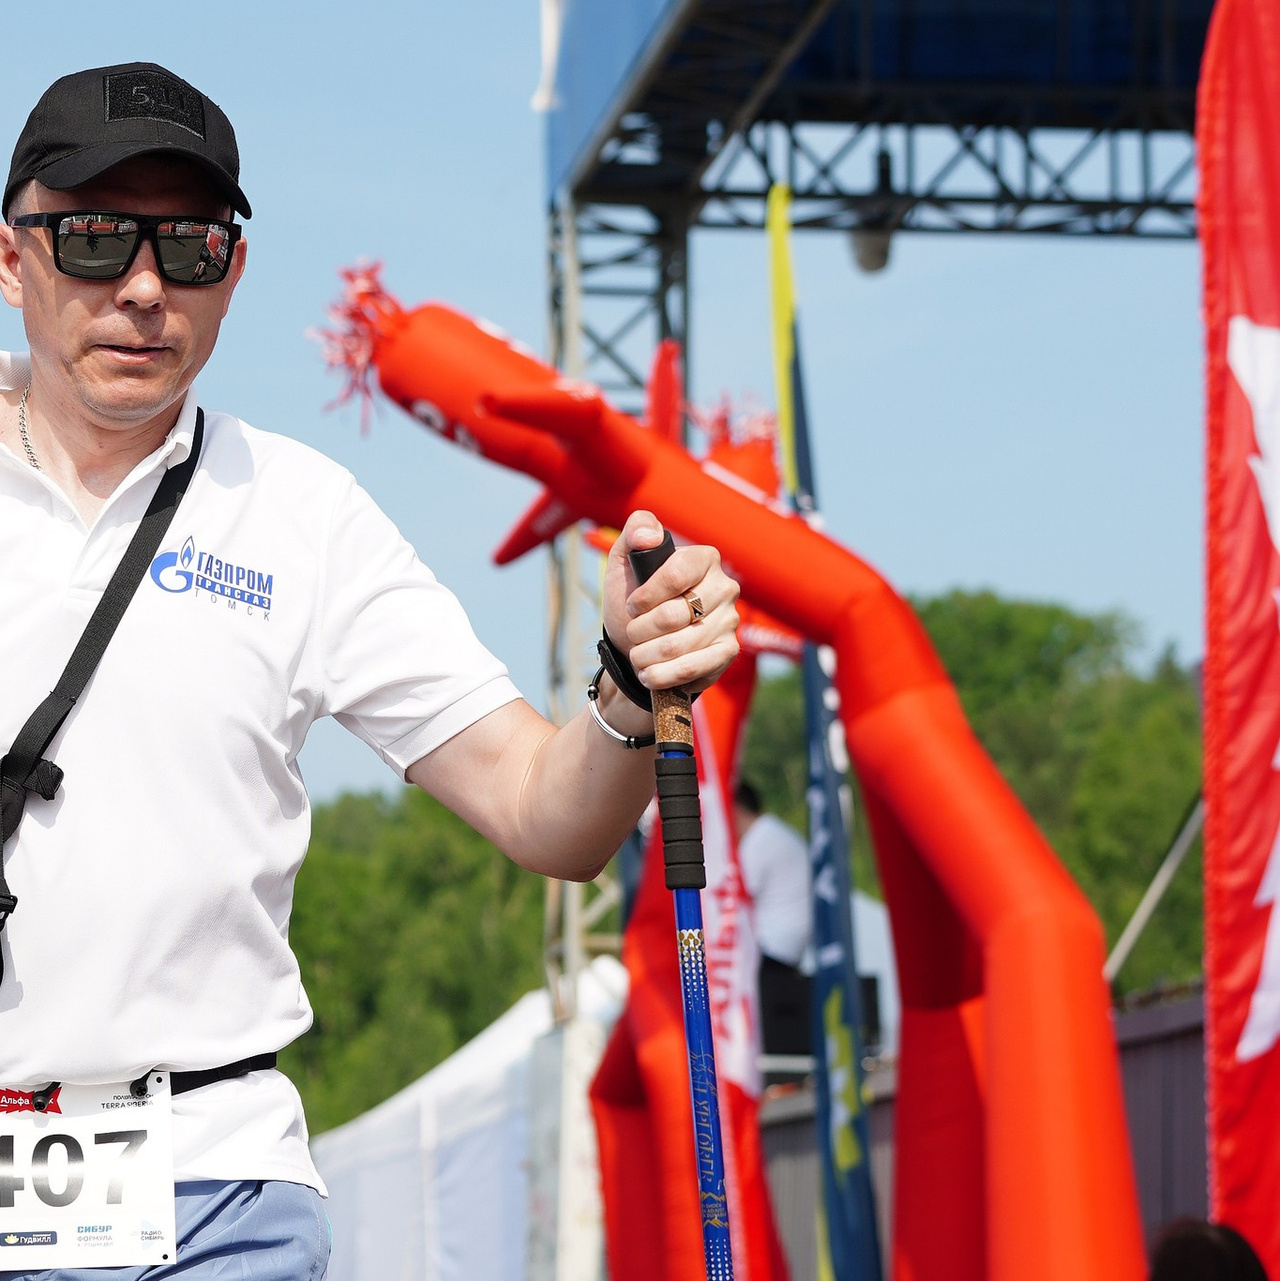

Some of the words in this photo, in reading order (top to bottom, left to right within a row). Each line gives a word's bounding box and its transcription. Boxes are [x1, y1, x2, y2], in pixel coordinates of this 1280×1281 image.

[197, 551, 273, 596] ГАЗПРОМ
[196, 574, 270, 609] ТРАНСГАЗ
[195, 587, 270, 622] ТОМСК
[1, 1095, 30, 1107] Альфа
[101, 1102, 126, 1110] TERRA
[77, 1225, 113, 1233] СИБУР
